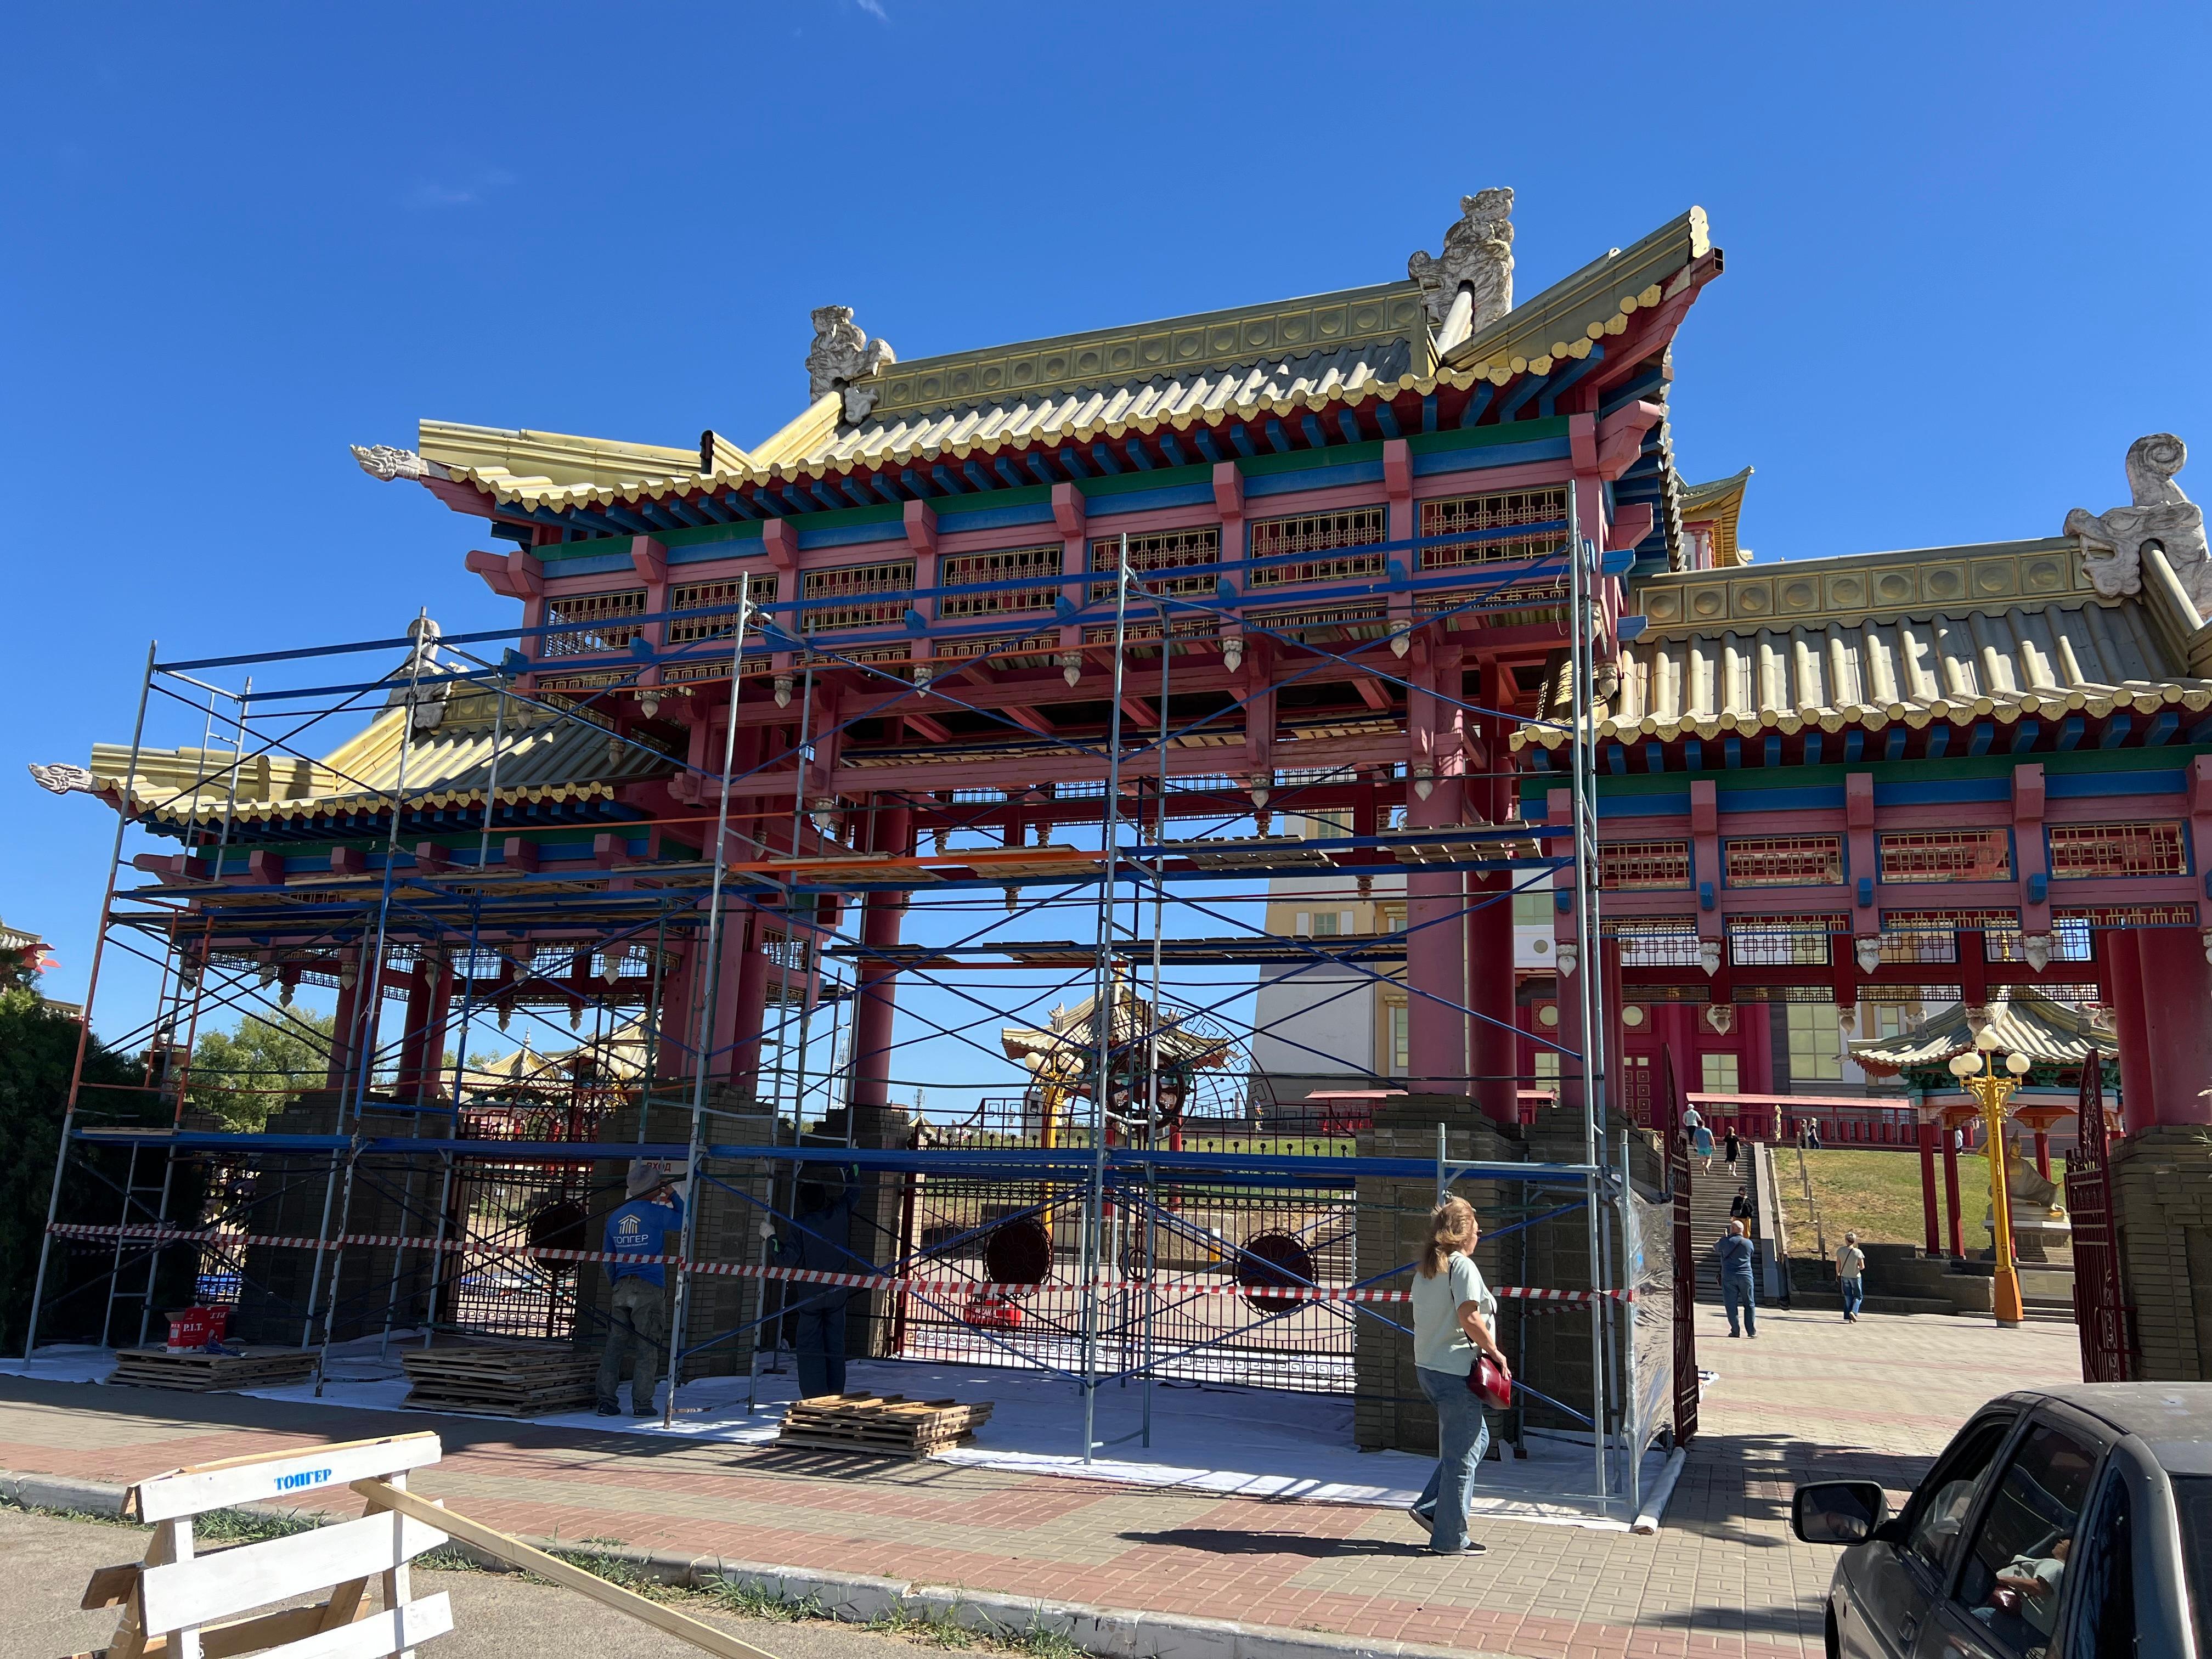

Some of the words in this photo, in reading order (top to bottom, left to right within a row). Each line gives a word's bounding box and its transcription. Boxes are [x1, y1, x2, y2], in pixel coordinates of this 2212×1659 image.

[613, 1234, 648, 1244] ТОПГЕР
[183, 1323, 204, 1332] P.I.T.
[274, 1469, 332, 1490] ТОПГЕР
